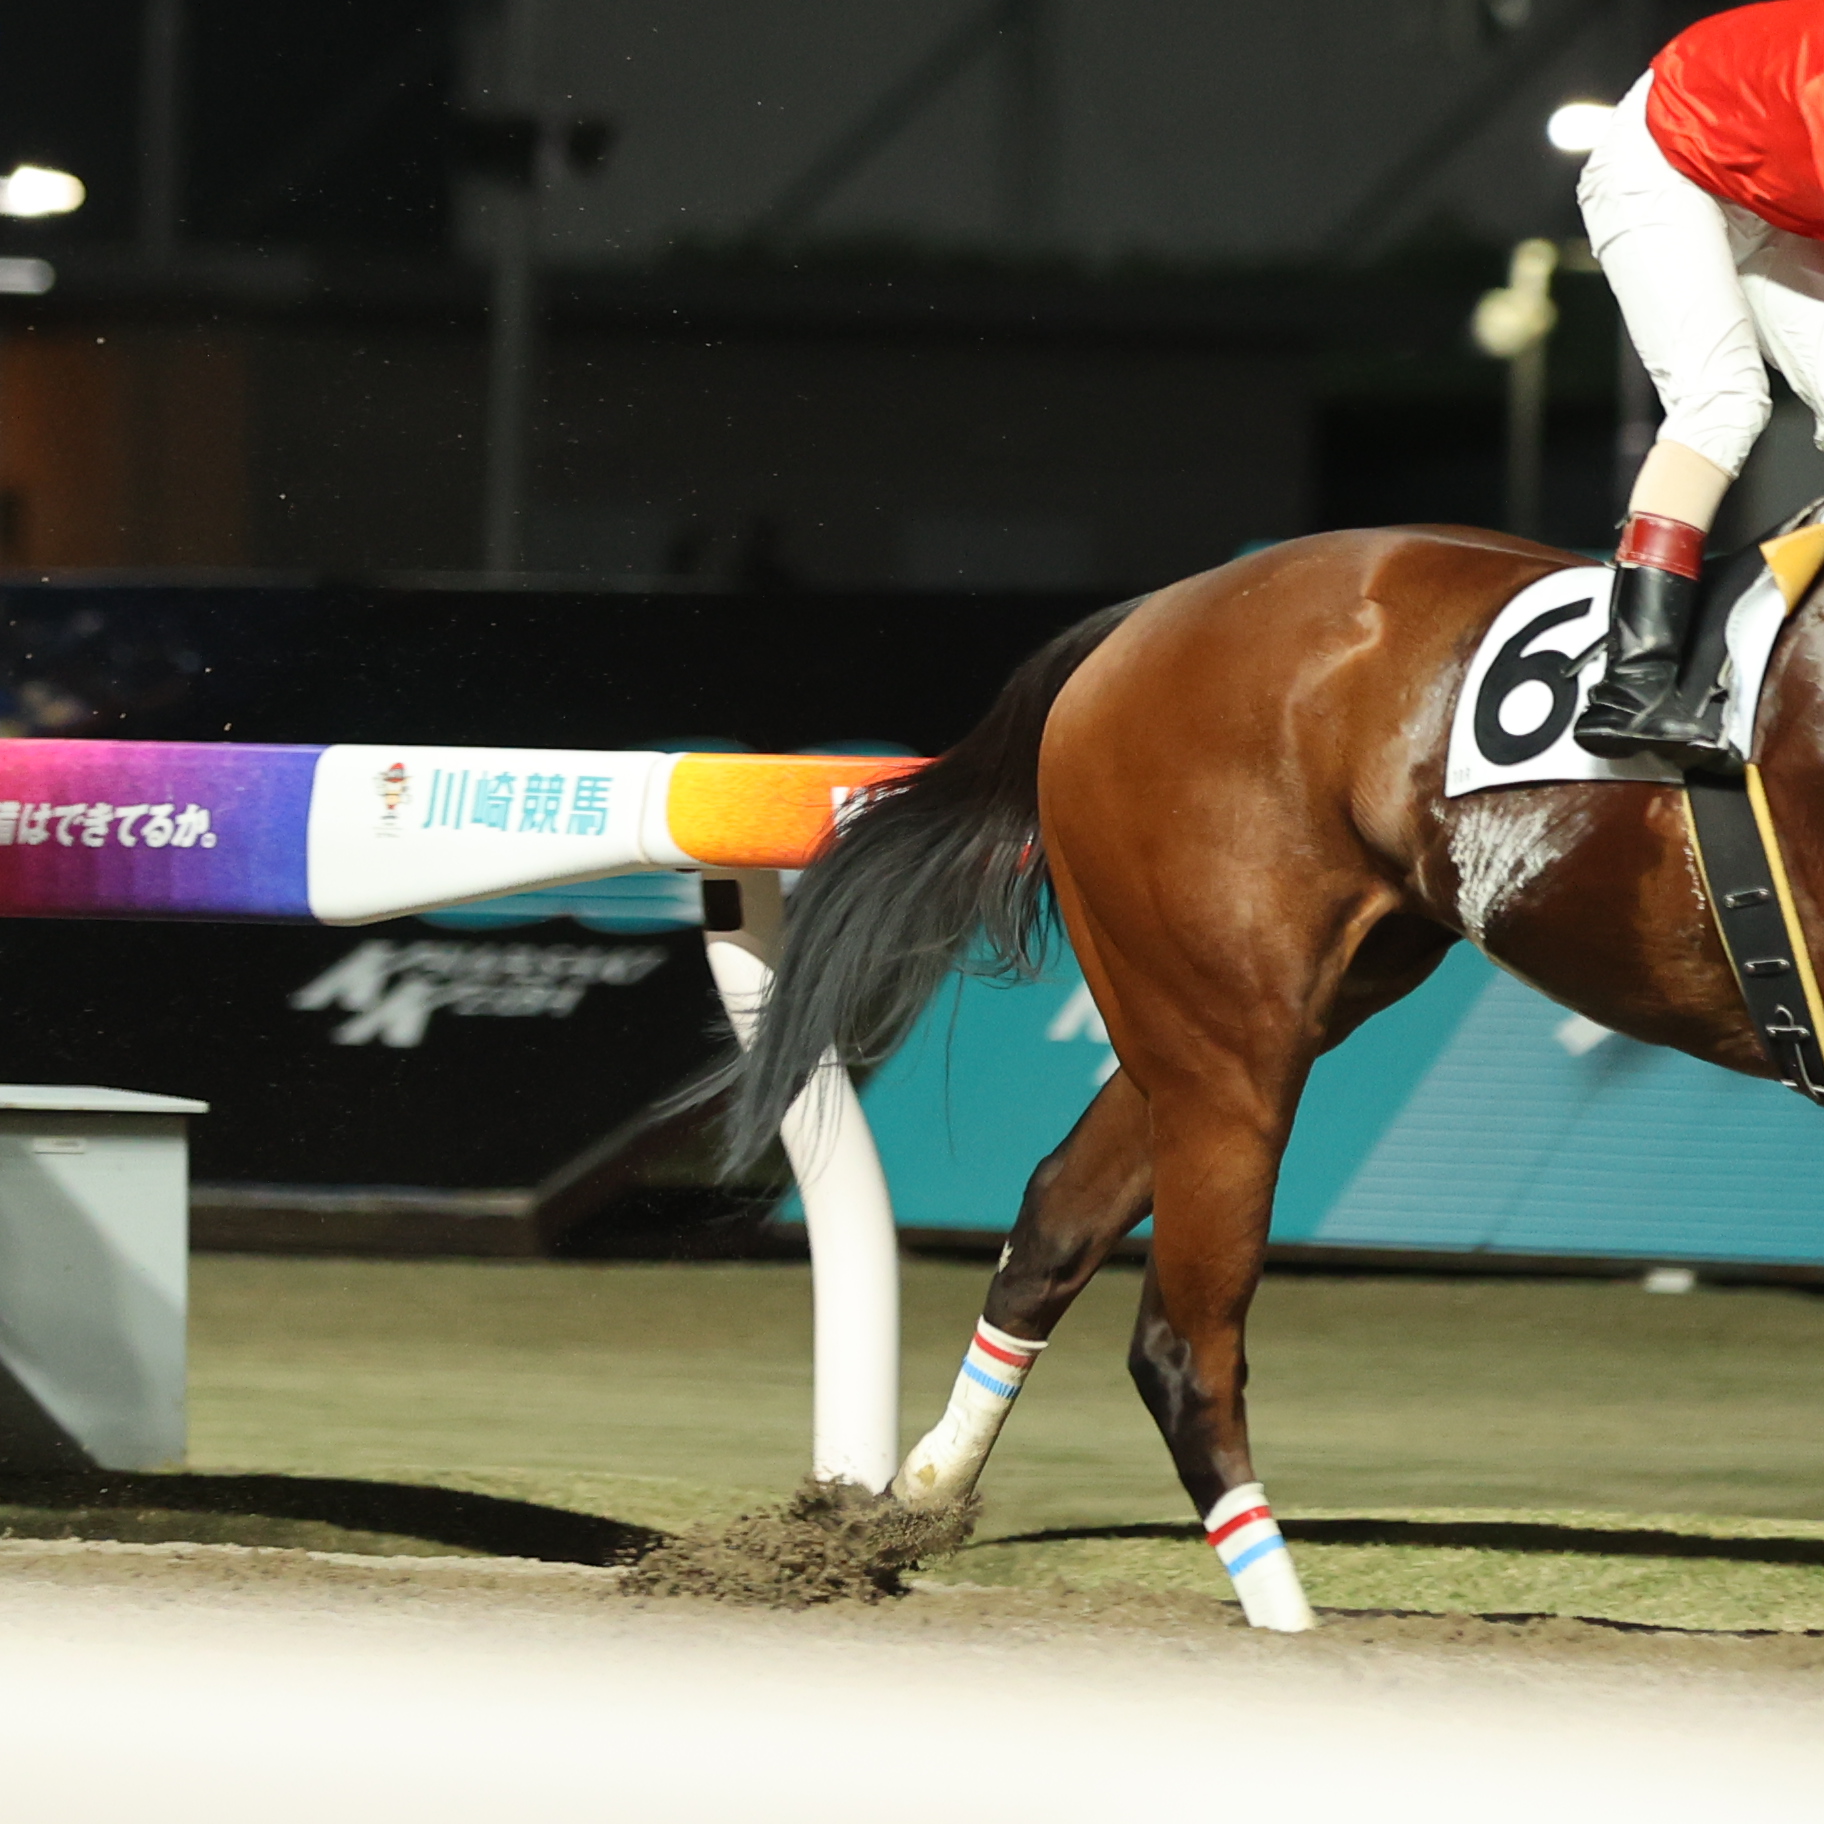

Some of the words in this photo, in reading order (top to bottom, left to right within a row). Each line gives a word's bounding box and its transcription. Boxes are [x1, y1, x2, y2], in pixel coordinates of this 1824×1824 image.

[1474, 597, 1580, 766] 6
[421, 769, 614, 836] 川崎競馬
